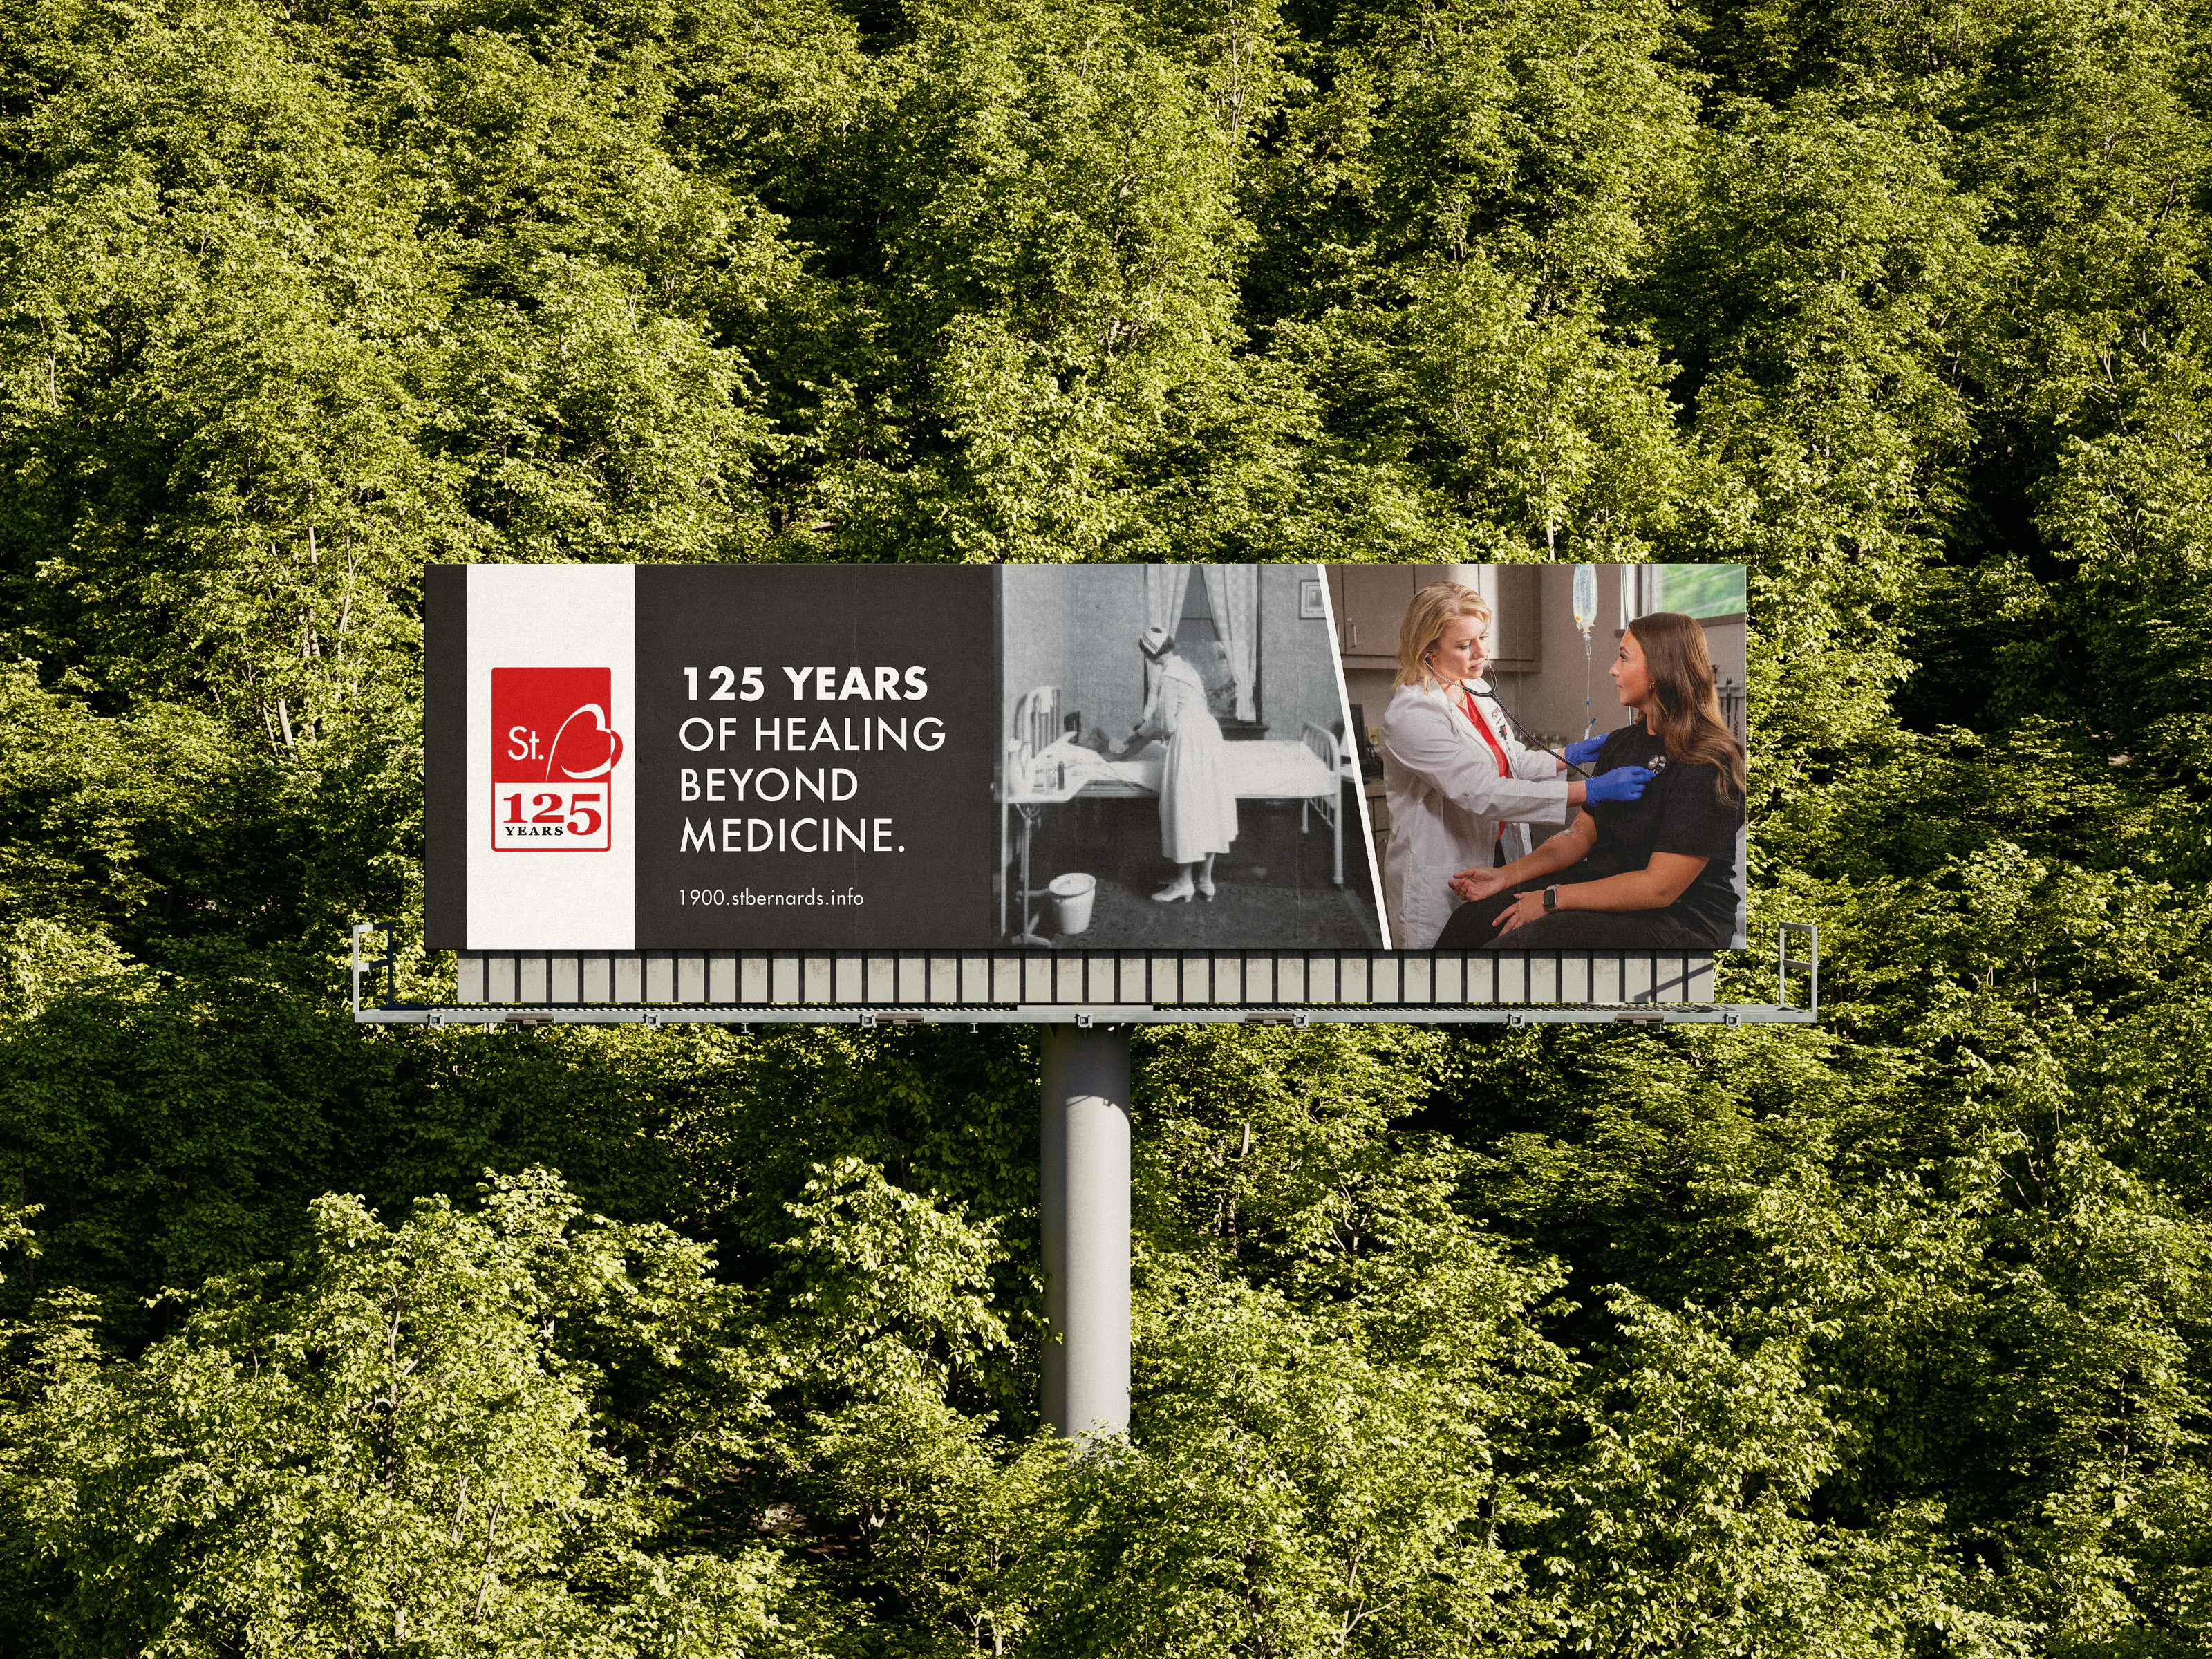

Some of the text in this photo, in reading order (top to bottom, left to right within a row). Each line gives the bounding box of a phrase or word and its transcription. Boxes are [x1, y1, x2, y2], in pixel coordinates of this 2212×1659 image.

[684, 665, 928, 702] 125 YEARS
[507, 725, 544, 760] St.
[679, 715, 946, 752] OF HEALING
[680, 766, 859, 803] BEYOND
[503, 793, 602, 836] 125
[504, 826, 563, 836] YEARS
[679, 816, 906, 854] MEDICINE.
[679, 887, 865, 906] 1900.stbernards.info
